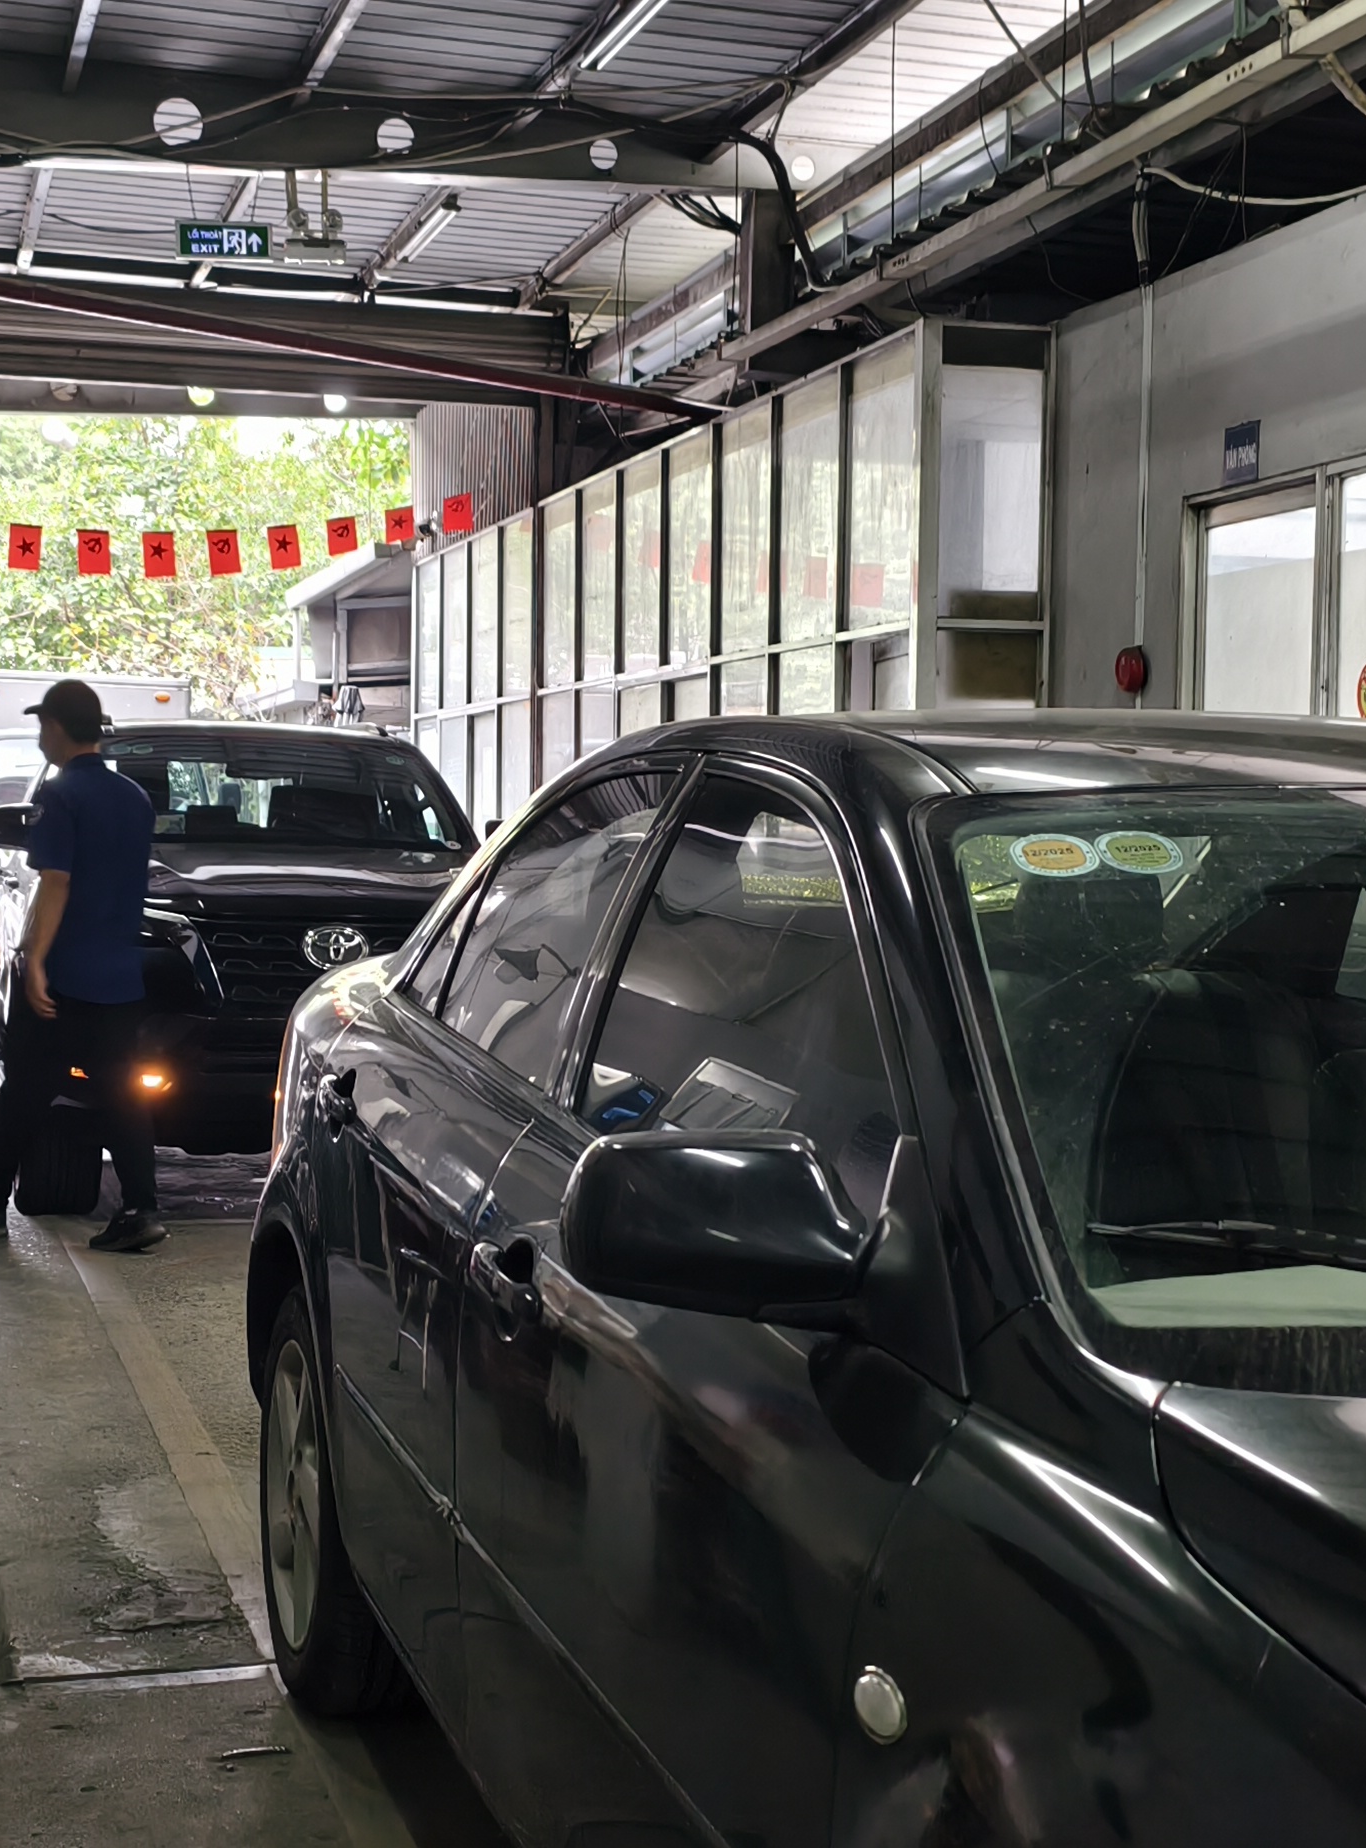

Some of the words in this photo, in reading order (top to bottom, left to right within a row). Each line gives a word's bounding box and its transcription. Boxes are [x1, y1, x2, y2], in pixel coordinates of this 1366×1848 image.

[191, 242, 220, 253] EXIT
[1023, 846, 1074, 857] 12/2025
[1115, 844, 1161, 853] 12/2025
